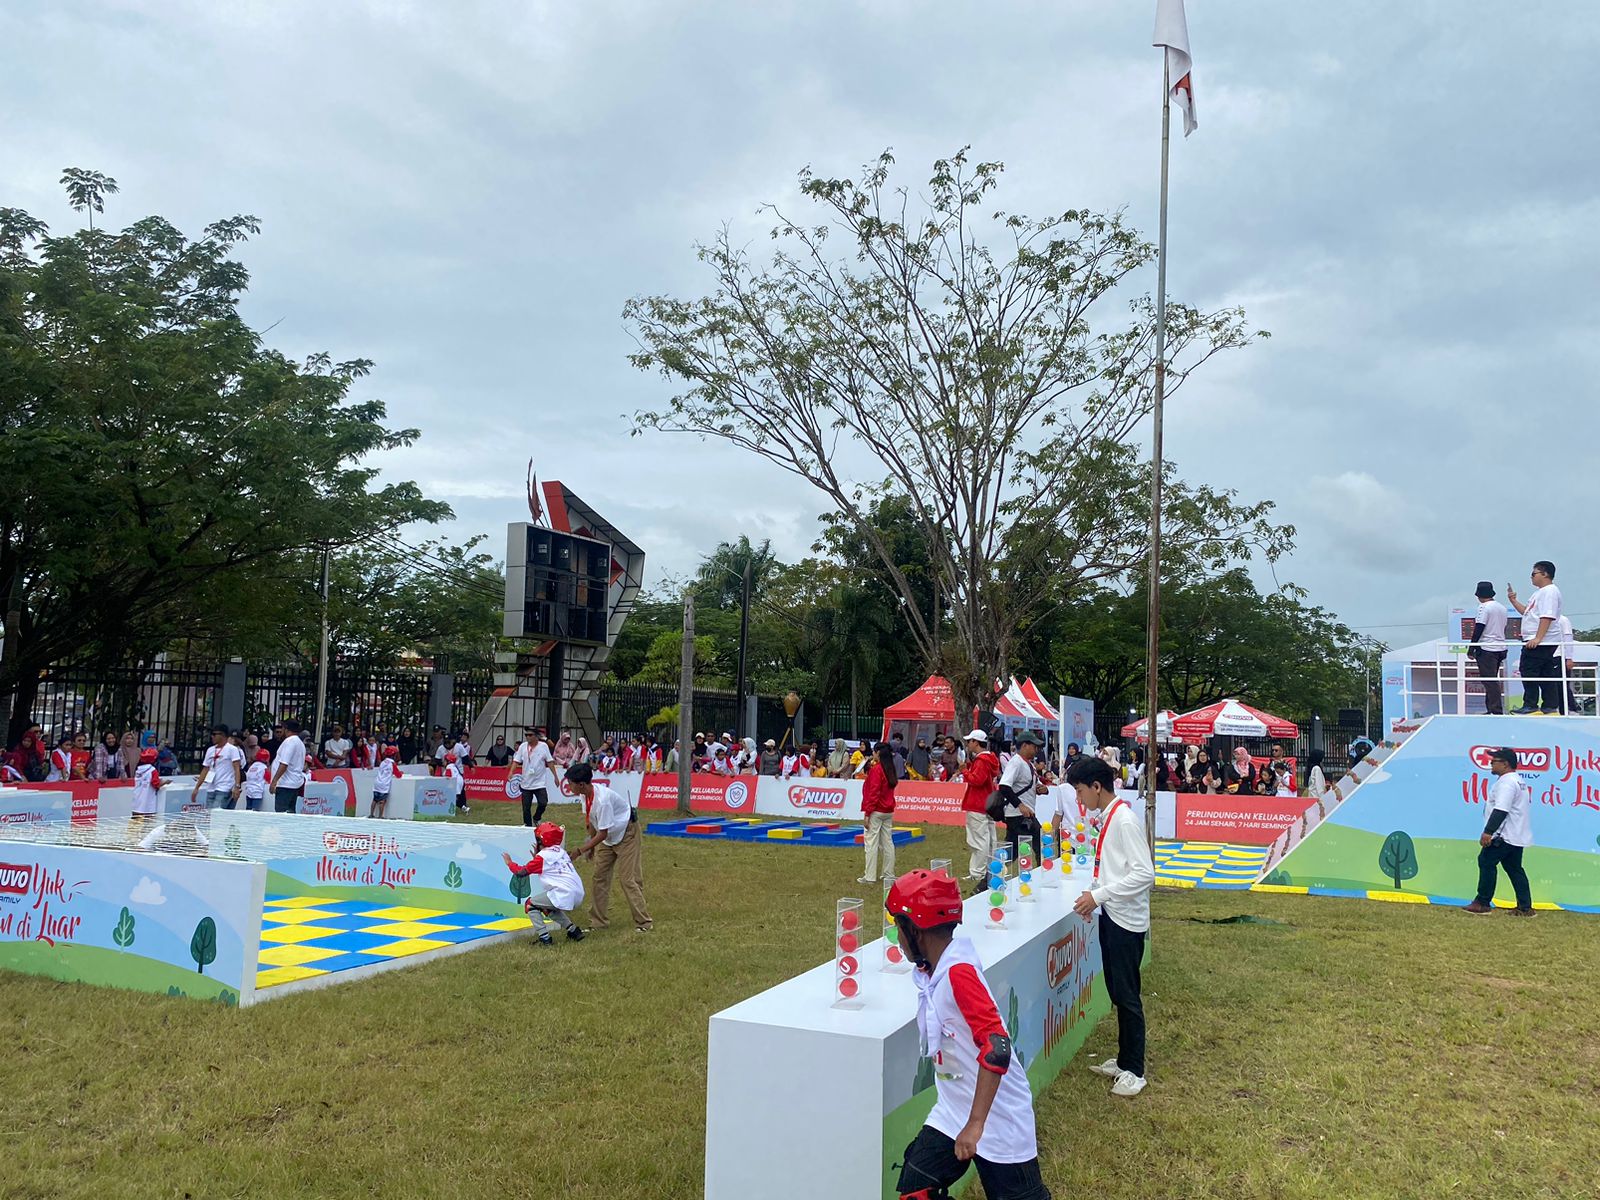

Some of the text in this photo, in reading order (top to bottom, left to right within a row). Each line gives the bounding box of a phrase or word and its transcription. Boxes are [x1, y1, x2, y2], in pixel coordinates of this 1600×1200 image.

[1515, 745, 1600, 782] VO Yuk
[646, 785, 678, 793] PERLINDUN
[803, 790, 843, 804] NUVO
[895, 796, 943, 804] ERLINDUNGAN
[1541, 784, 1562, 807] di
[1571, 775, 1600, 810] Lu
[1186, 810, 1297, 822] PERLINDUNGAN KELUARGA
[1210, 820, 1237, 828] SEHARI,
[336, 838, 367, 850] NUVO
[316, 855, 416, 890] Main di Luar
[33, 863, 66, 909] Yuk
[0, 895, 21, 904] AMILY
[16, 912, 31, 940] di
[35, 901, 81, 948] Luar
[1056, 940, 1072, 974] NUVO
[1044, 998, 1068, 1060] Main
[1077, 967, 1094, 1022] Luar
